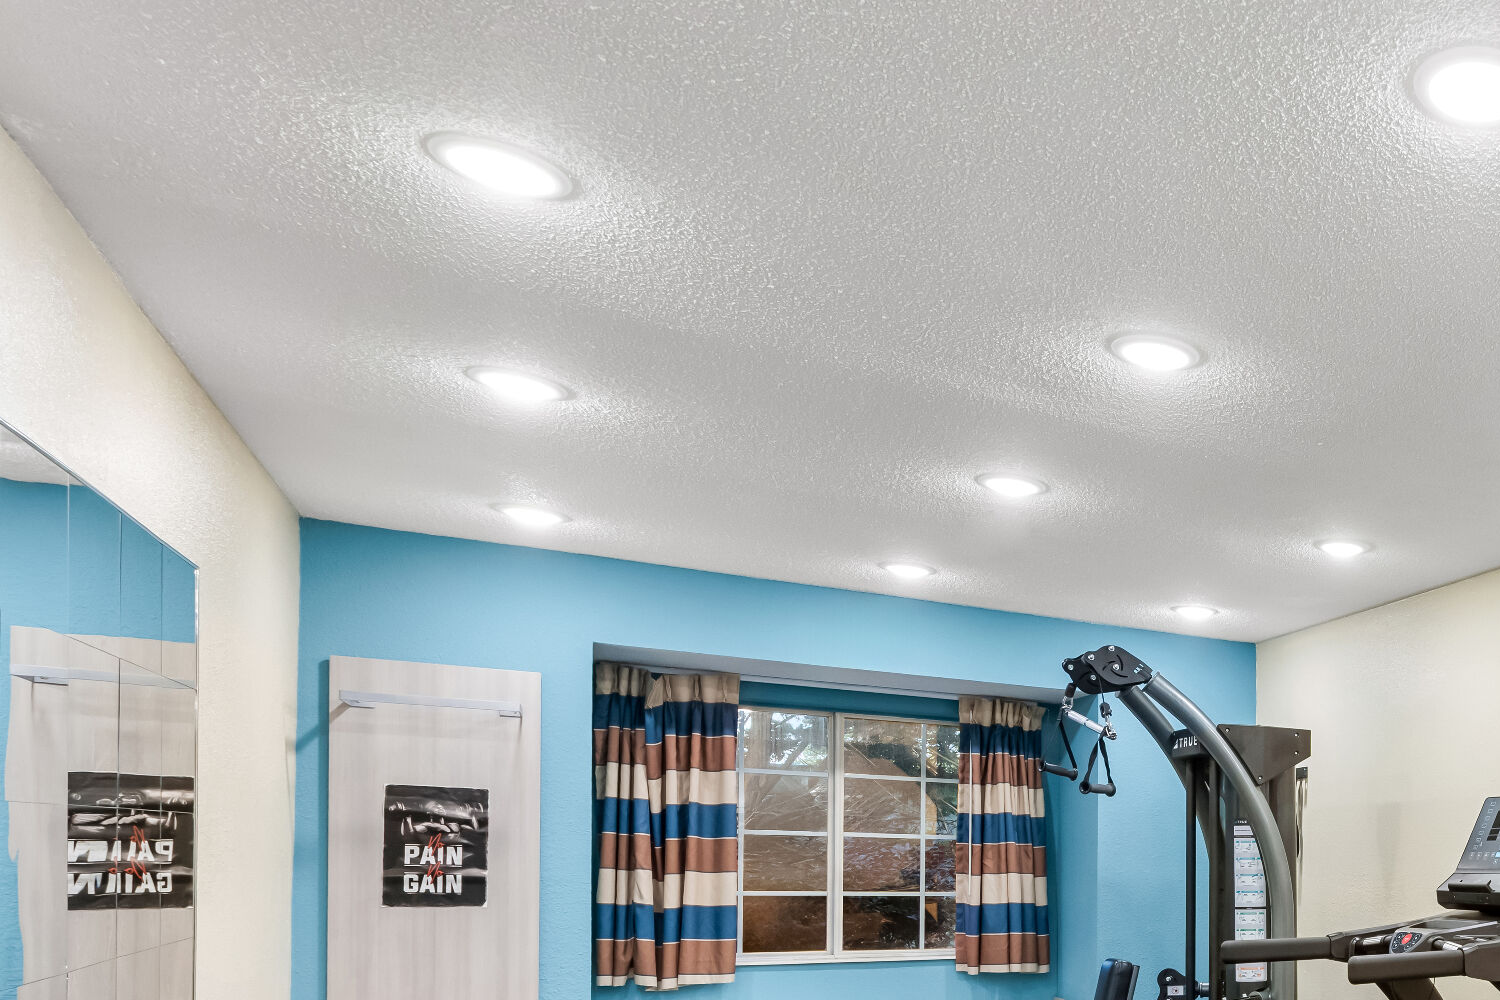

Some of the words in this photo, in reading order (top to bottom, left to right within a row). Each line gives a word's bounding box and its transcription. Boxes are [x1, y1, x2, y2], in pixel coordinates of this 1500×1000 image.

[1178, 736, 1198, 748] TRUE
[404, 845, 463, 866] PAIN
[403, 874, 462, 895] GAIN
